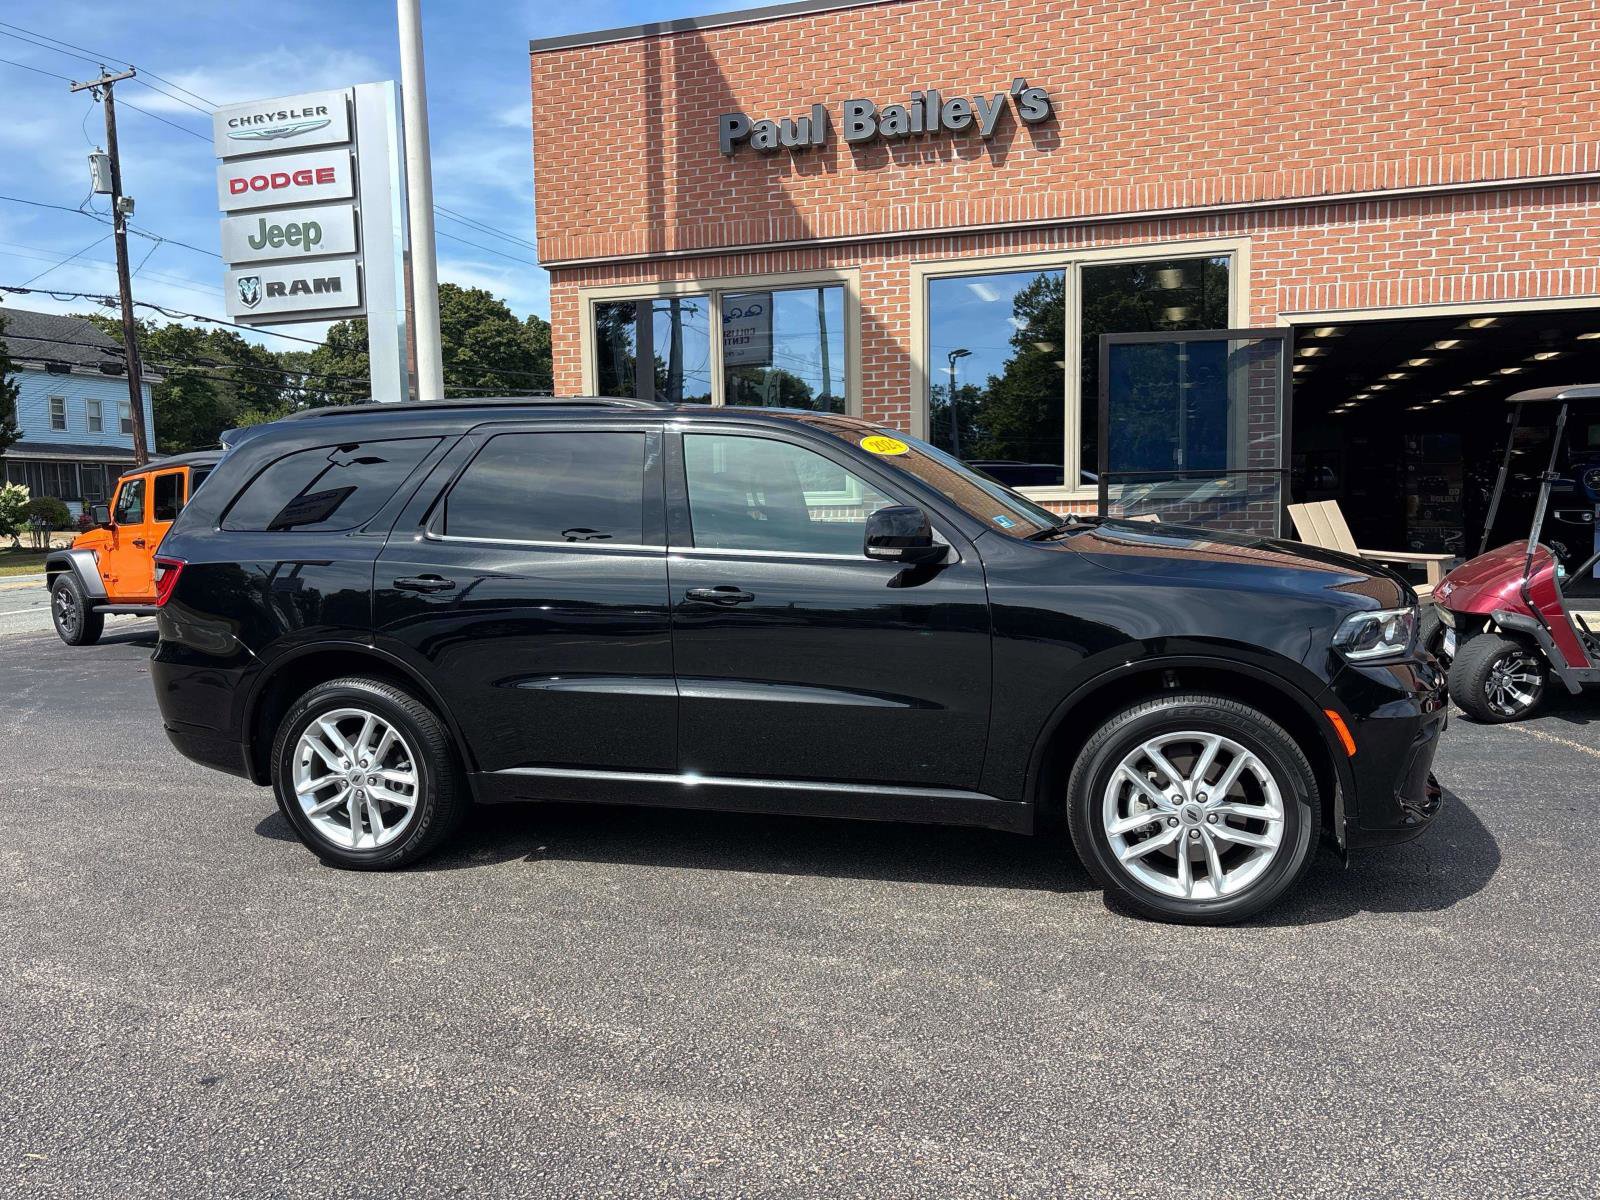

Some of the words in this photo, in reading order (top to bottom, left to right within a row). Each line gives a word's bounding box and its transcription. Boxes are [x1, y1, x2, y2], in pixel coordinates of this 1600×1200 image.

[228, 105, 329, 128] CHRYSLER
[720, 103, 827, 156] Paul
[843, 78, 1051, 142] Bailey's
[229, 167, 336, 195] DODGE
[248, 217, 322, 251] Jeep
[266, 276, 342, 298] RAM
[869, 439, 903, 451] 2024
